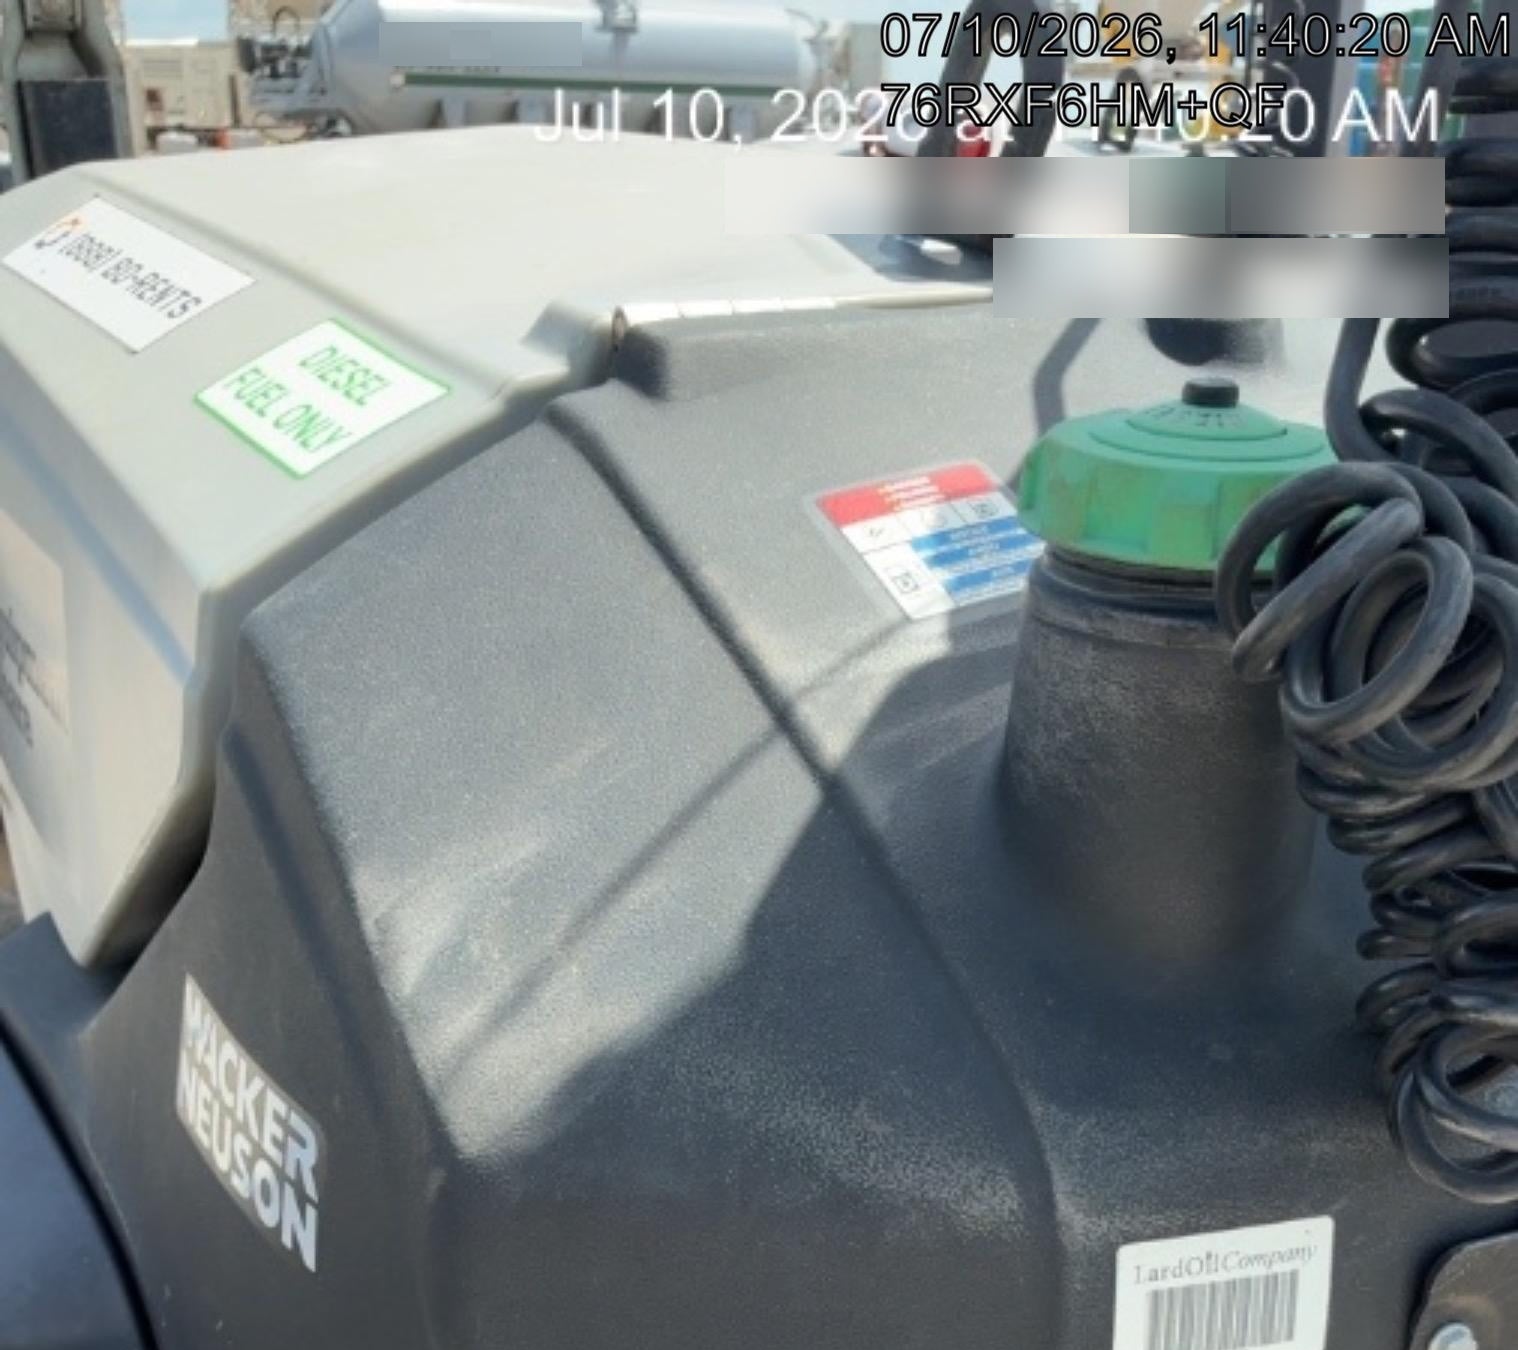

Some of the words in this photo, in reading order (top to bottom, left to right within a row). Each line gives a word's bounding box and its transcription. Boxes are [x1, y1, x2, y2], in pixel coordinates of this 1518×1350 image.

[223, 367, 289, 418] FUEL
[272, 404, 353, 453] ONLY
[298, 345, 391, 406] DIESEL
[177, 1047, 319, 1274] NEUSON
[182, 974, 320, 1204] WACKER
